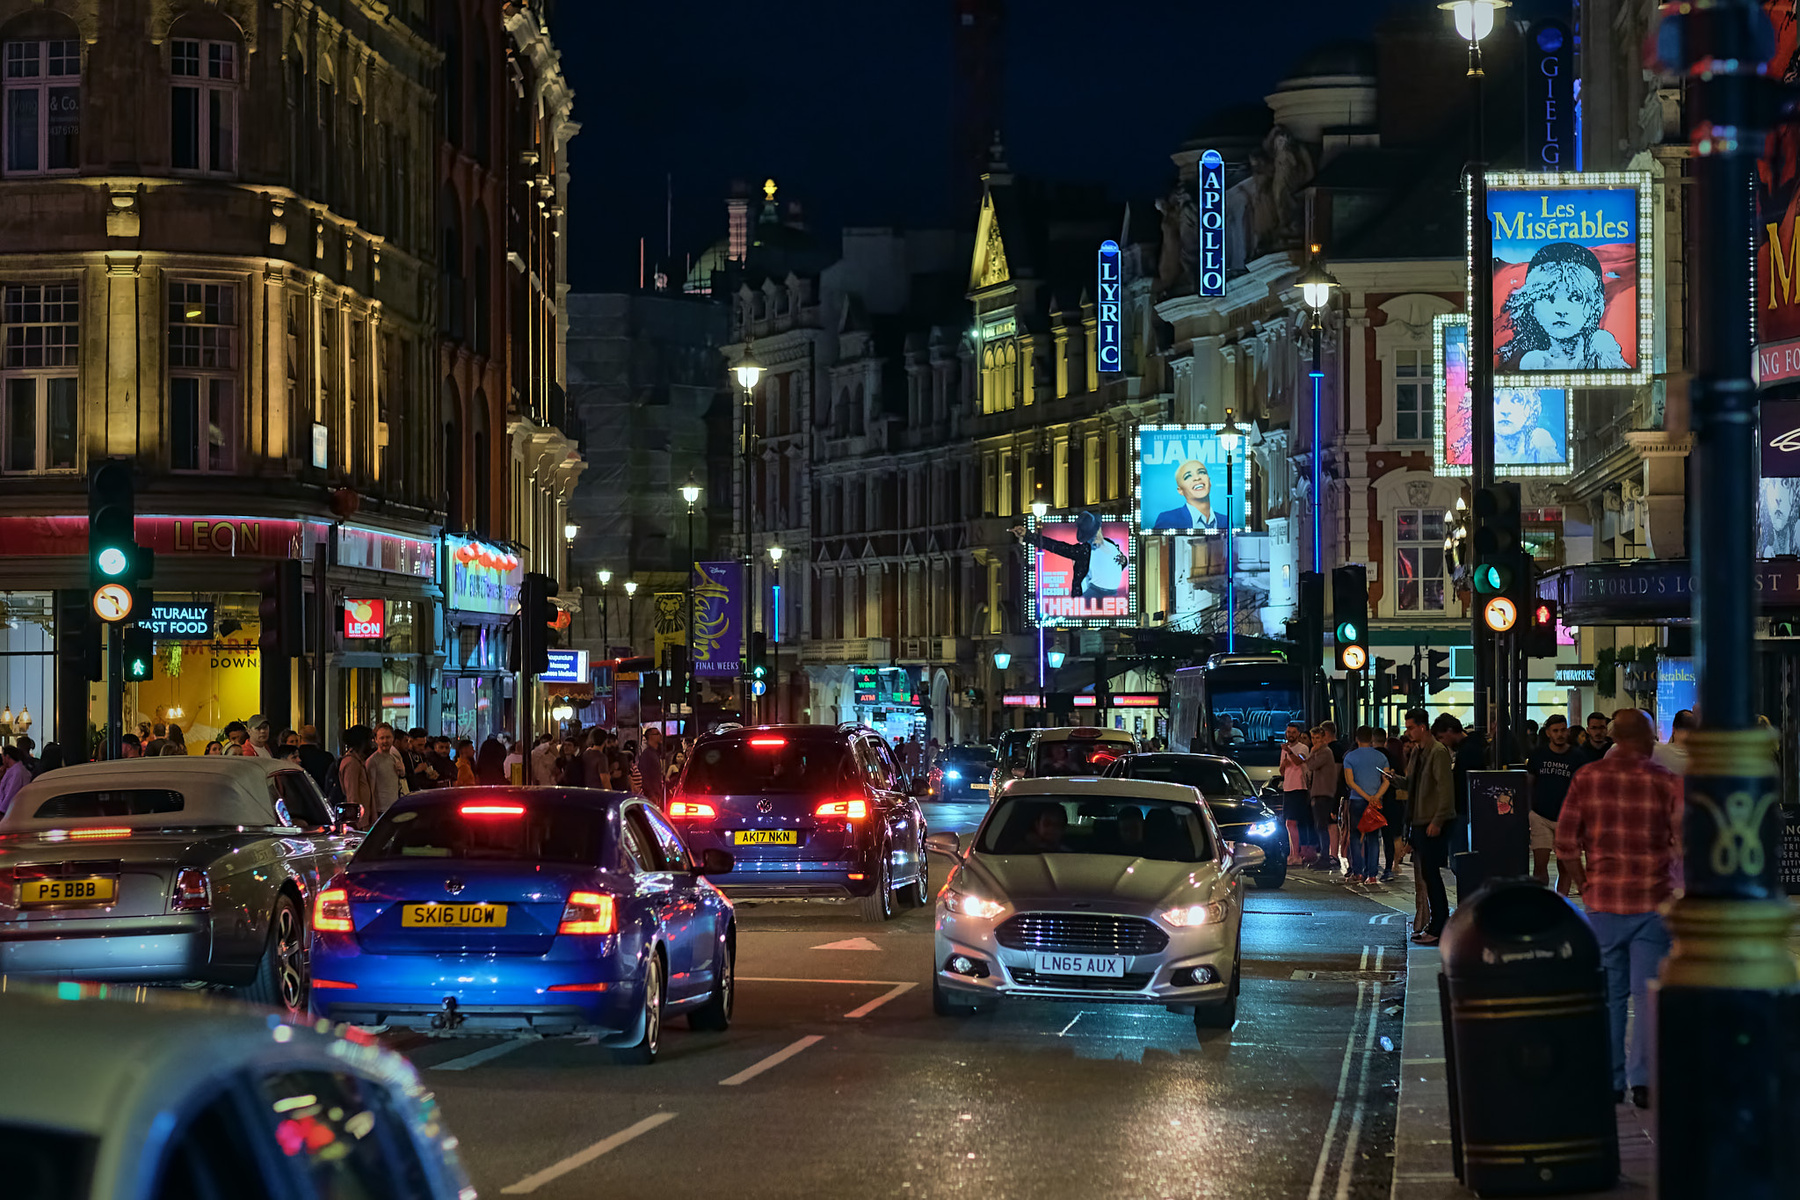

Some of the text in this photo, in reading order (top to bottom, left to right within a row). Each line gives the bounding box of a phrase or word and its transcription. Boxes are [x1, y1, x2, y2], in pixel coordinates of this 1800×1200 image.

[1541, 196, 1575, 218] Les
[1203, 171, 1222, 290] APOLLO
[1493, 209, 1629, 240] Misérables
[1101, 262, 1119, 364] LYRIC
[1143, 438, 1243, 465] JAMIE
[174, 520, 260, 552] LEON
[1598, 575, 1666, 596] WORLD'S
[1041, 597, 1129, 616] THRILLER
[169, 621, 208, 634] FOOD
[348, 622, 381, 634] LEON
[184, 638, 255, 656] MORE
[695, 661, 739, 671] FINAL WEEKS
[857, 668, 877, 676] FOOD
[857, 681, 877, 689] WINE
[860, 694, 876, 702] ATM
[1540, 767, 1571, 778] HILFIGER
[1543, 761, 1569, 770] TOMMY
[742, 831, 790, 843] AK17 NKN
[39, 882, 96, 899] P5 BBB
[414, 907, 496, 924] SK16 UOW
[1042, 955, 1117, 974] LN65 AUX
